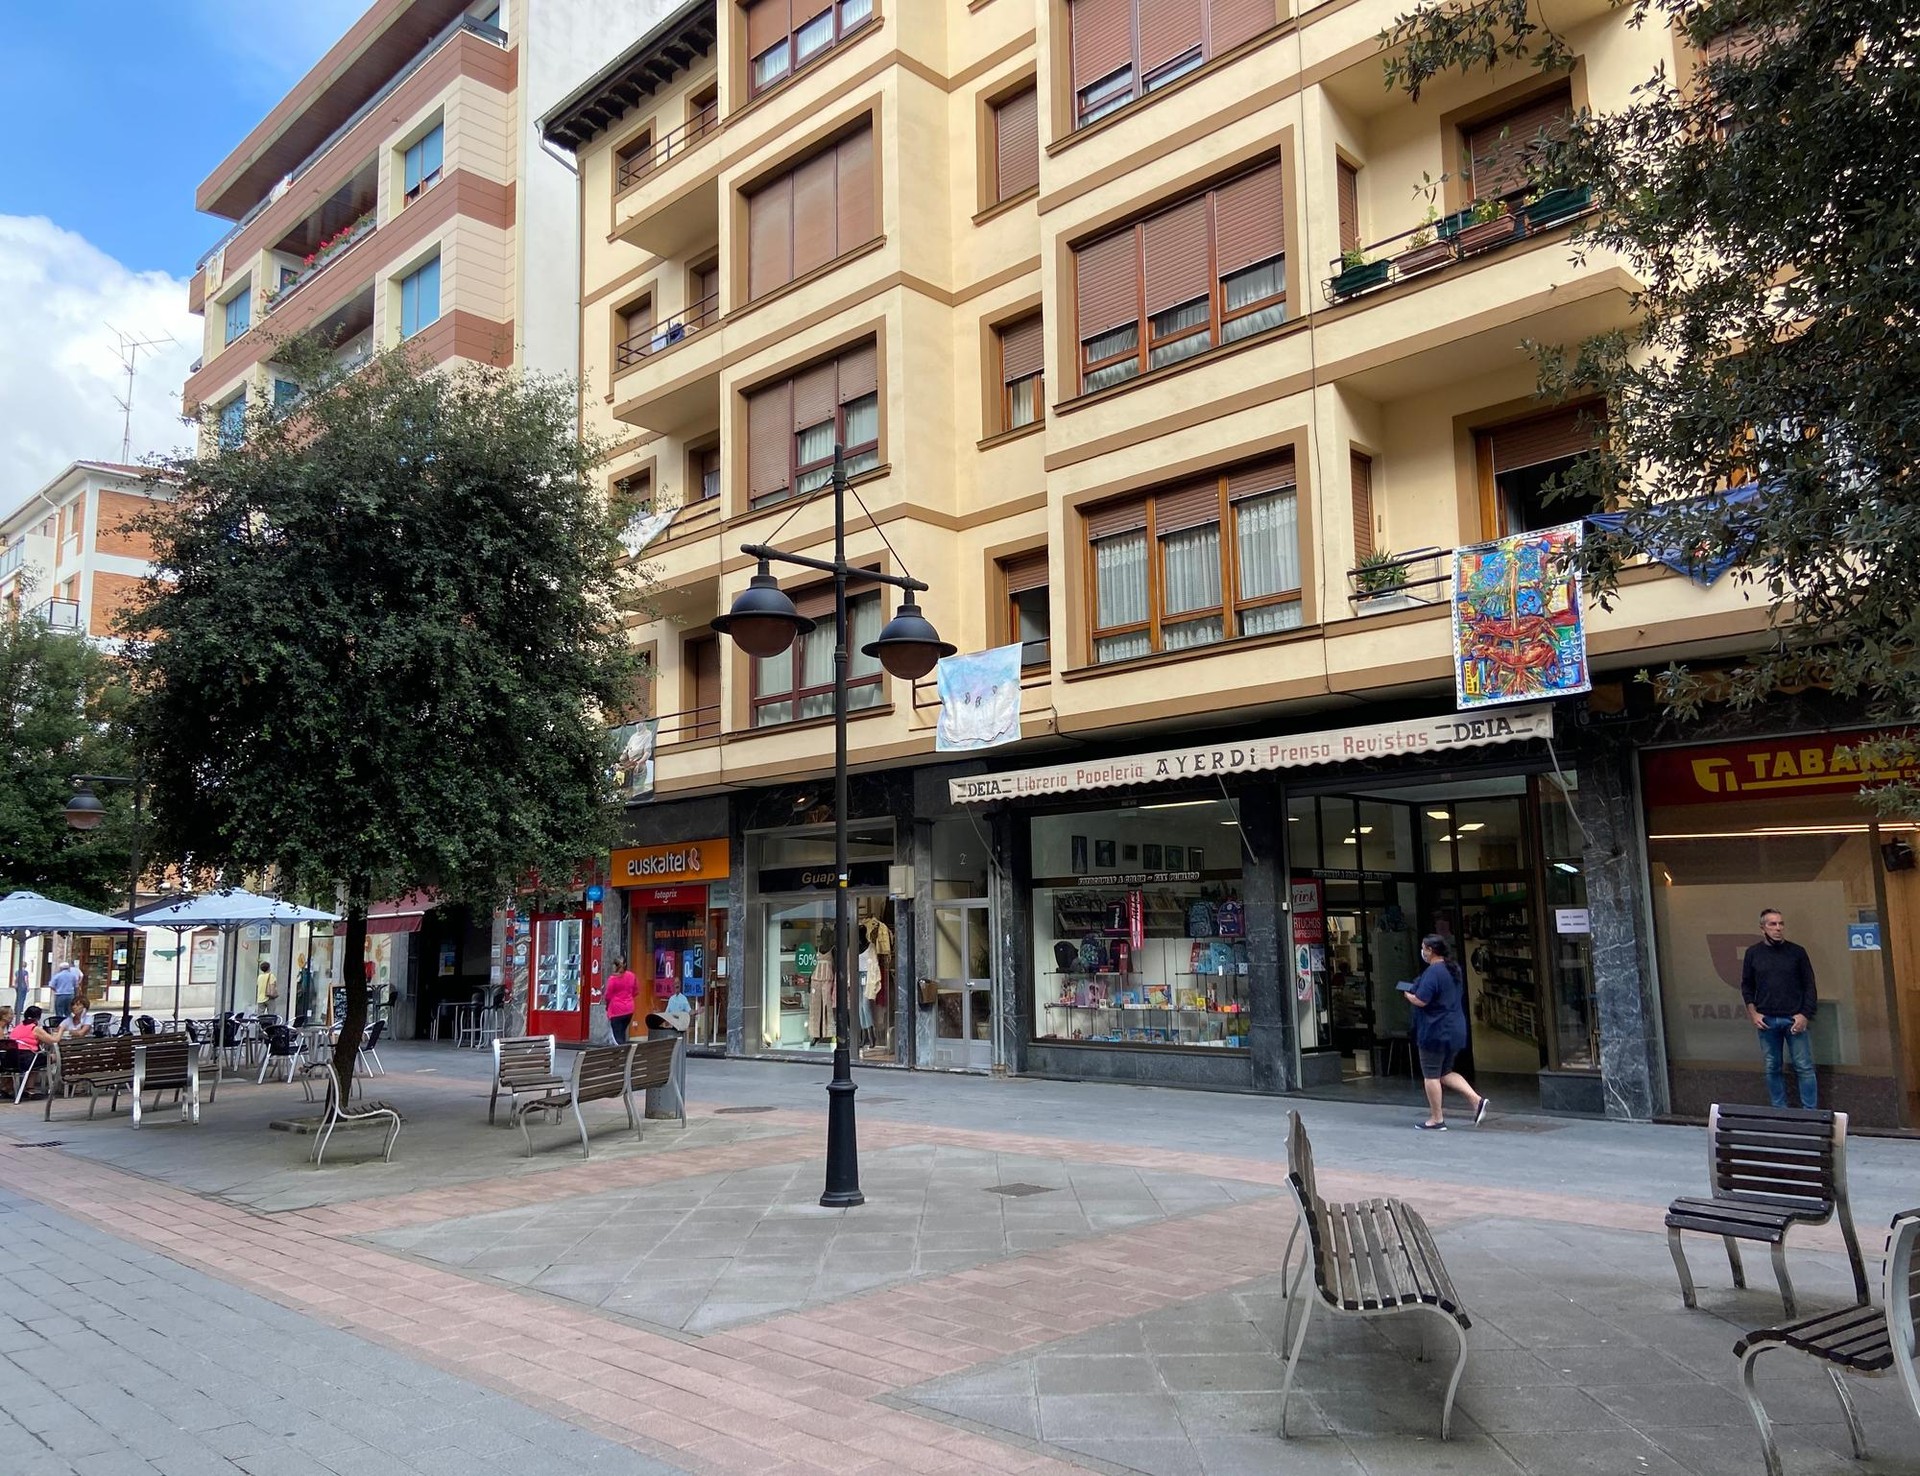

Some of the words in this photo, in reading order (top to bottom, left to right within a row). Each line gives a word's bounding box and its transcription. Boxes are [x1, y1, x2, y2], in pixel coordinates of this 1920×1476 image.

[1569, 630, 1582, 662] OKER
[967, 780, 1002, 798] DEIA
[1269, 743, 1331, 764] Prensa
[1343, 731, 1429, 755] Revistas
[1452, 716, 1515, 743] DEIA
[627, 849, 687, 876] euskaltel
[1292, 889, 1315, 904] rink
[1293, 917, 1321, 929] RTUCHOS
[798, 953, 818, 966] 50%
[1688, 1003, 1749, 1020] TABA
